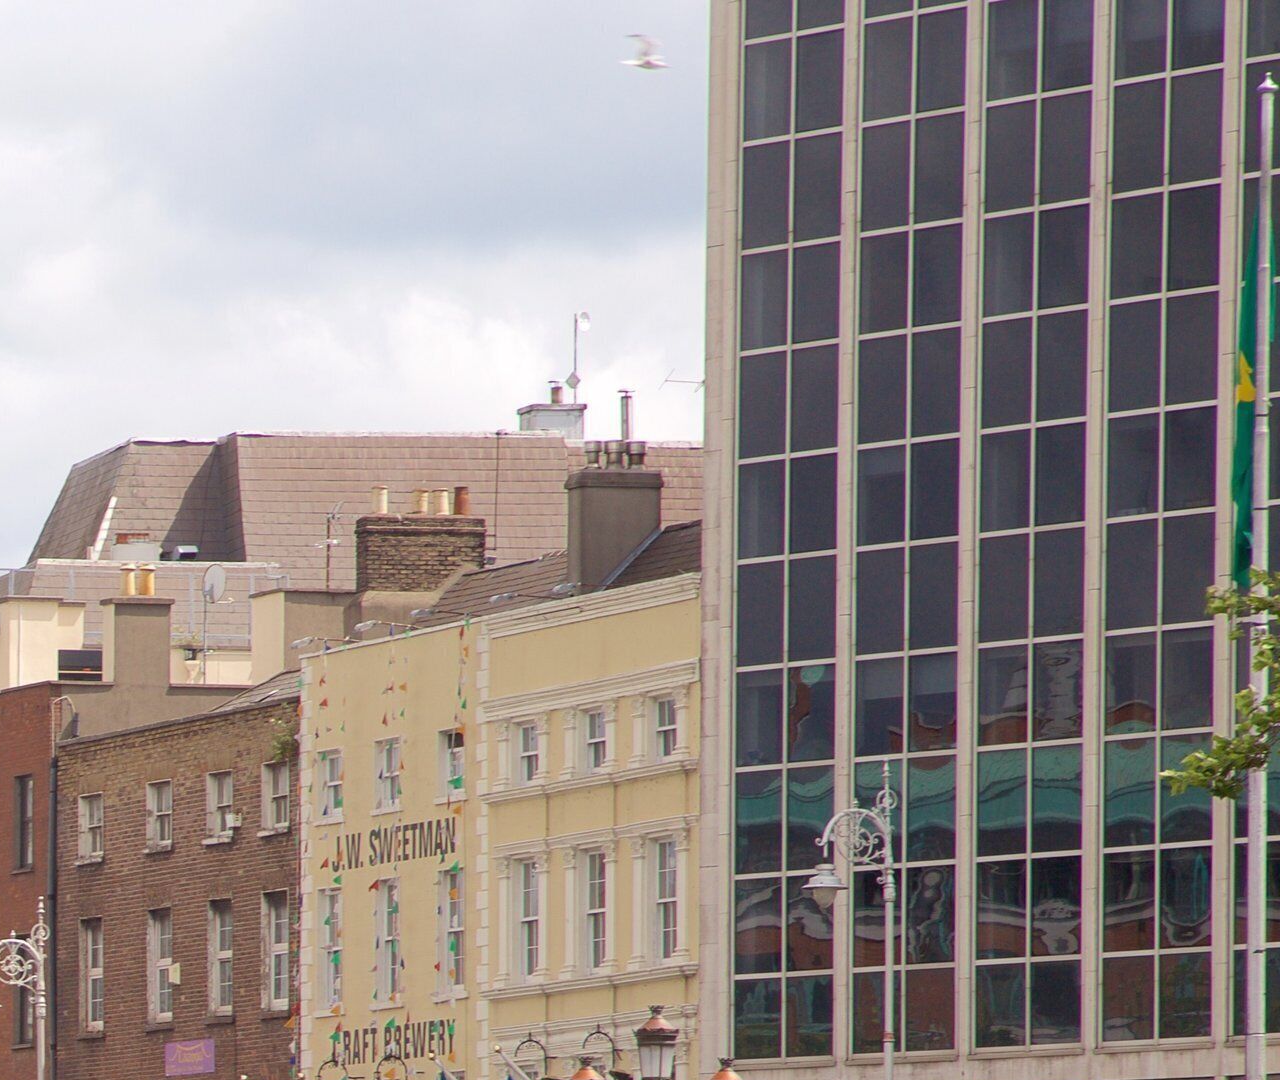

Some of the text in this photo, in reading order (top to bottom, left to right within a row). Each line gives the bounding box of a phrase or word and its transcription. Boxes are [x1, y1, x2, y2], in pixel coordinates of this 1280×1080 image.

[332, 817, 456, 872] J.W. SWEETMAN
[384, 1018, 456, 1062] BREWERY
